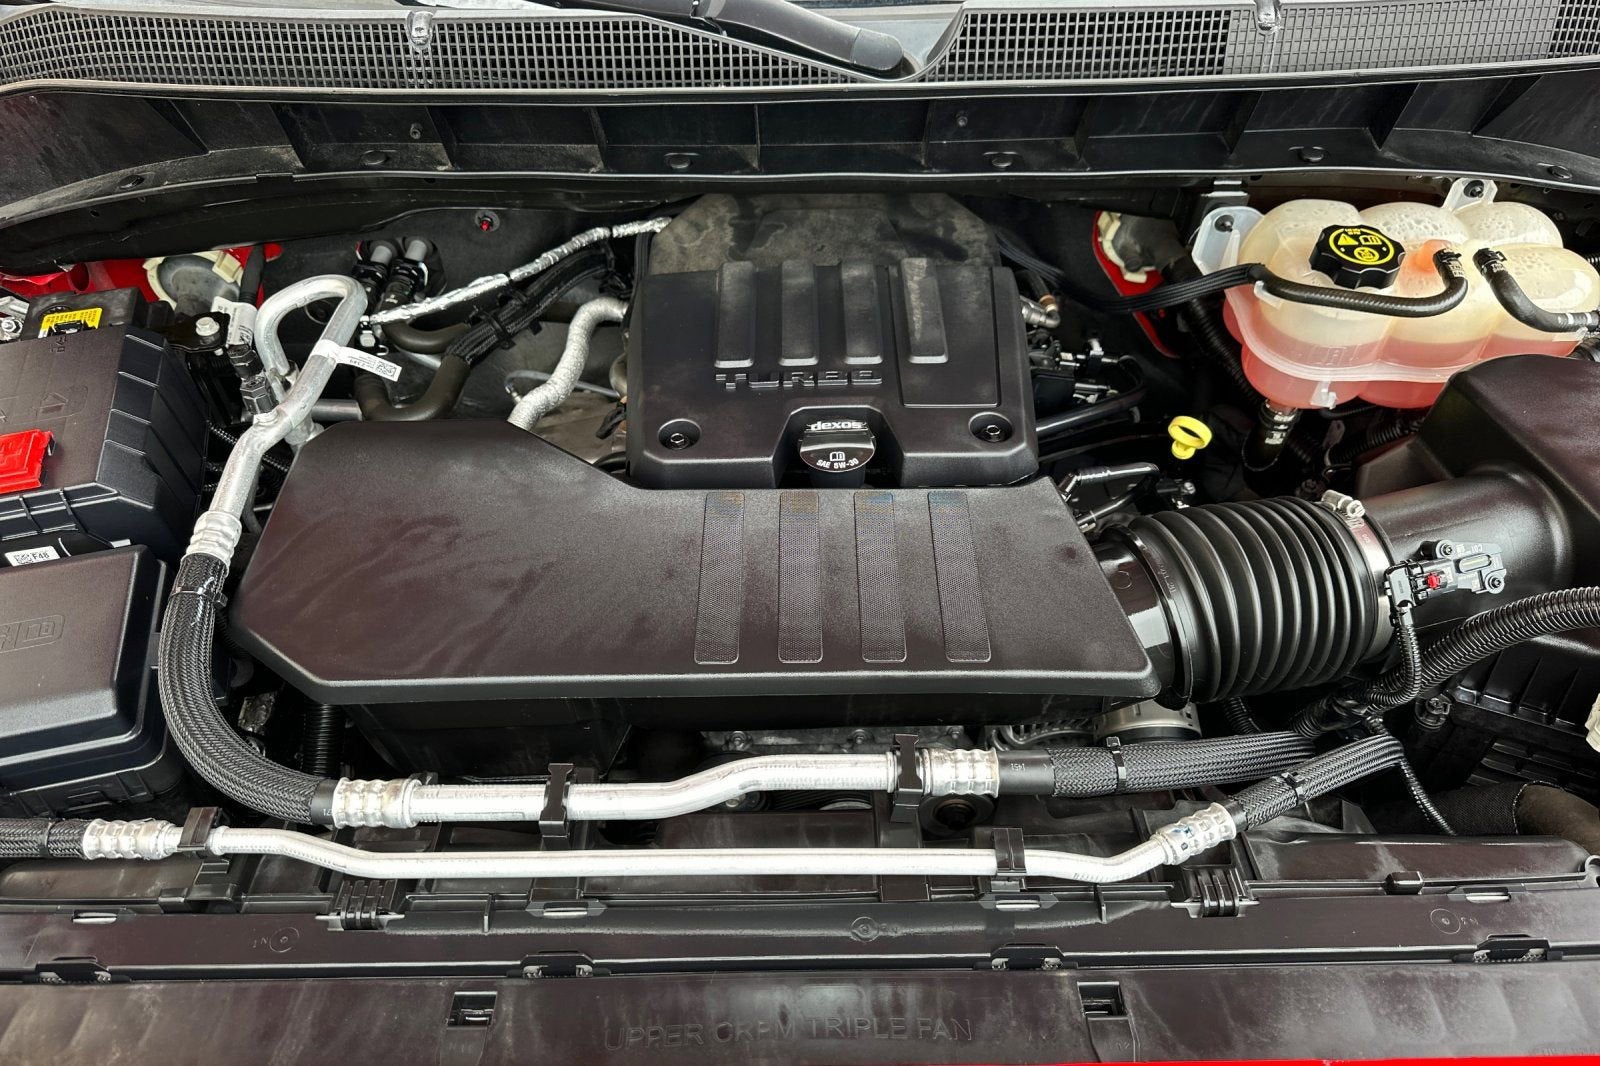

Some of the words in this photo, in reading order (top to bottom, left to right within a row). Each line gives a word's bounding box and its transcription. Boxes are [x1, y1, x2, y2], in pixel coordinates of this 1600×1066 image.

[715, 370, 883, 389] TURBO
[810, 420, 864, 431] dexos
[816, 459, 831, 469] SAE
[833, 457, 859, 469] 5W-30
[604, 1022, 704, 1050] UPPER
[806, 1016, 909, 1040] TRIPLE
[917, 1017, 973, 1041] FAN
